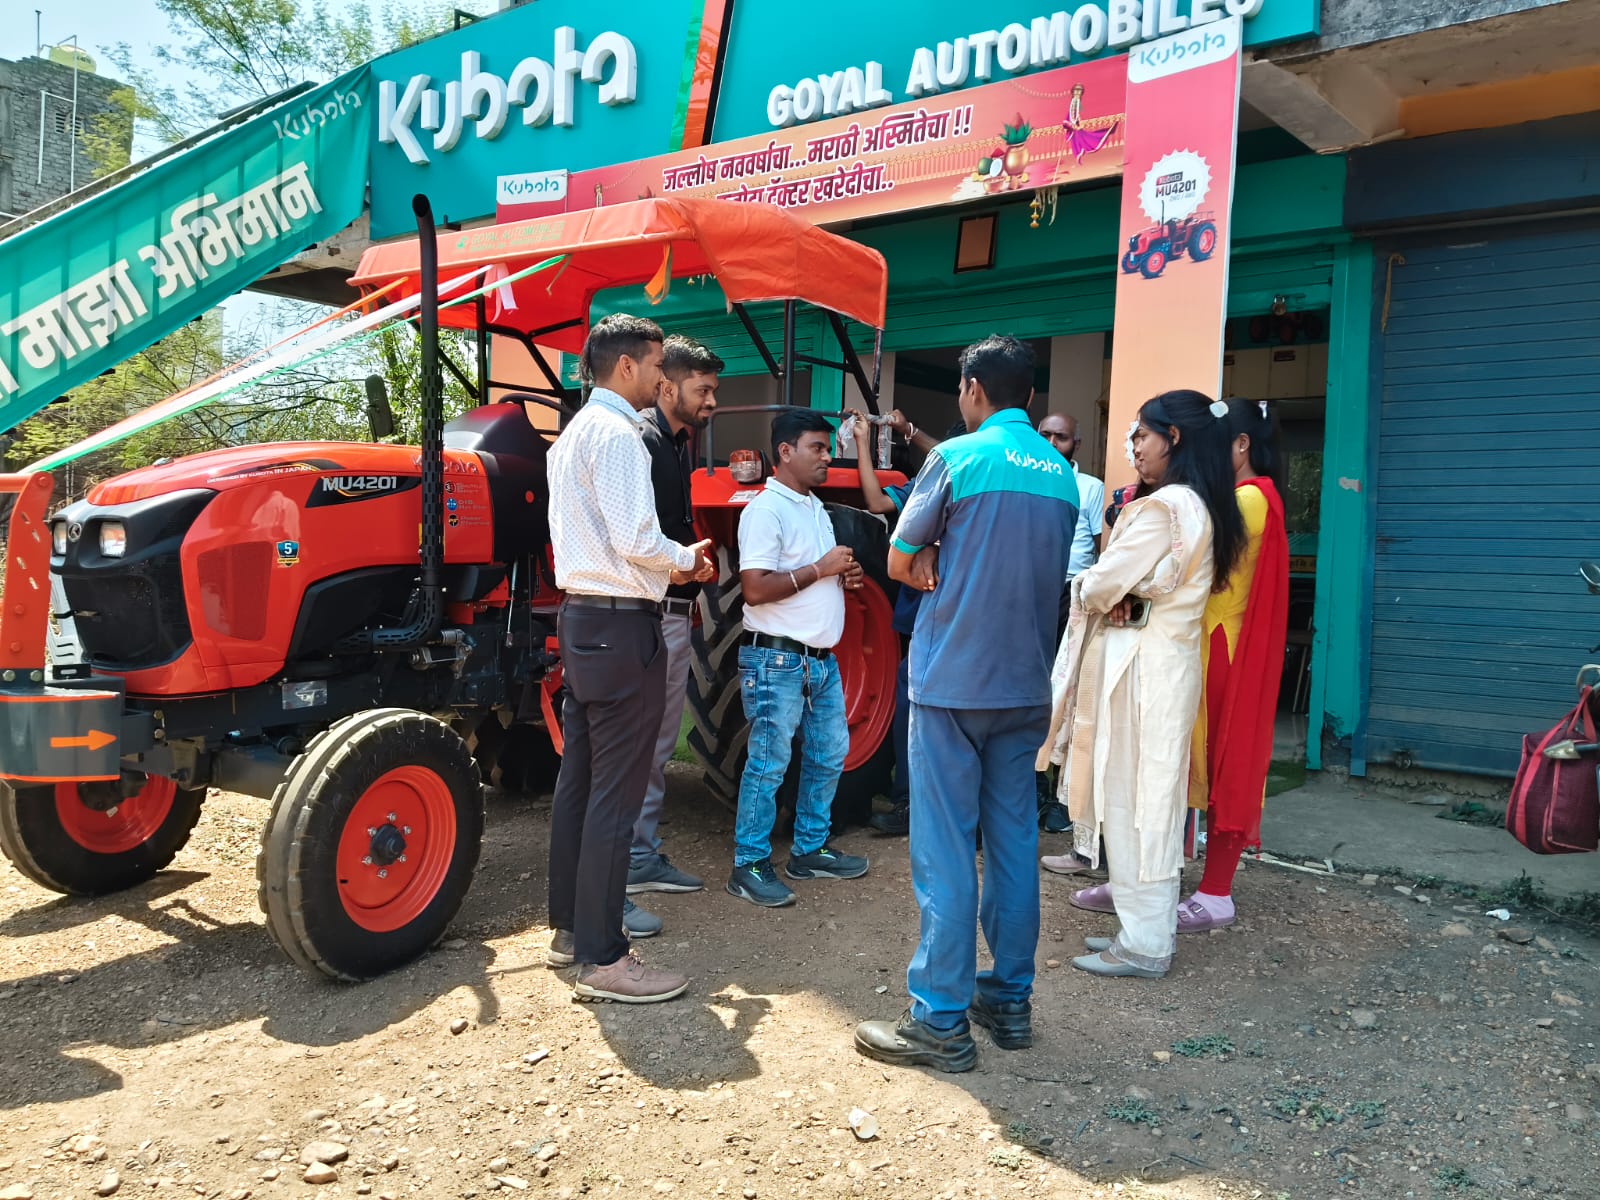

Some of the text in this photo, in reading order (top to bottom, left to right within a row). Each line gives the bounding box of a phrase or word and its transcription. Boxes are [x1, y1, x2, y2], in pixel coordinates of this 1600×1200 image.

[1140, 32, 1226, 66] Kubota
[379, 26, 637, 165] Kubota
[767, 61, 892, 127] GOYAL
[272, 90, 362, 140] Kubota
[663, 156, 717, 191] जल्लोष
[862, 107, 950, 152] अस्मितेचा
[503, 177, 559, 195] Kubota
[1155, 179, 1197, 198] MU4201
[0, 161, 323, 370] माझा अभिमान
[1005, 448, 1062, 475] Kubota
[322, 476, 397, 491] MU4201
[284, 542, 293, 554] 5
